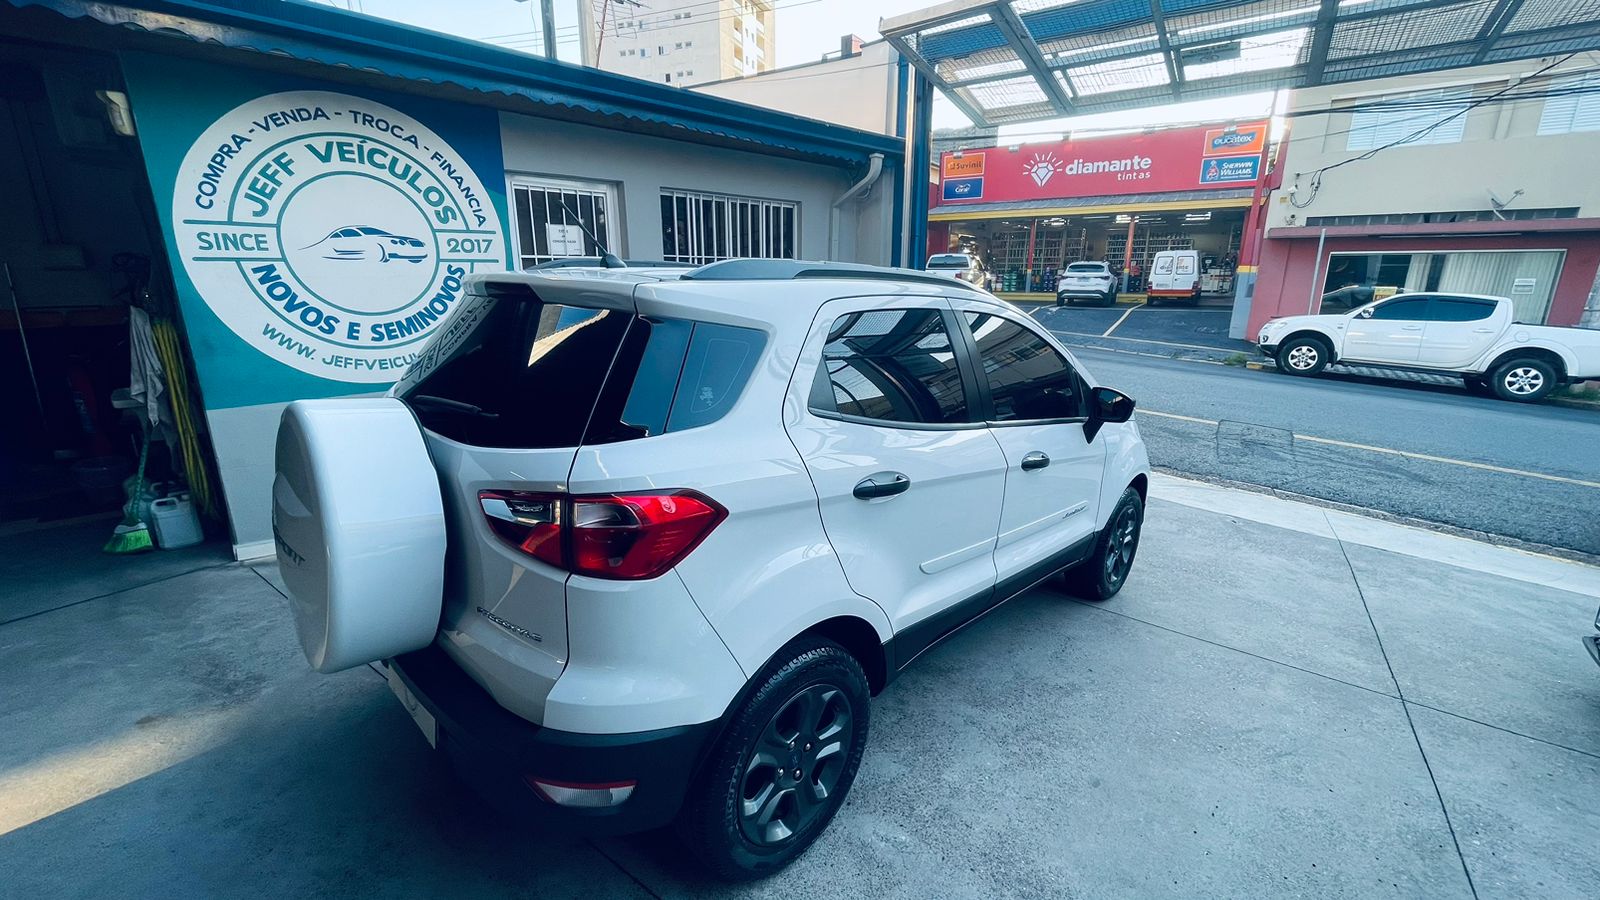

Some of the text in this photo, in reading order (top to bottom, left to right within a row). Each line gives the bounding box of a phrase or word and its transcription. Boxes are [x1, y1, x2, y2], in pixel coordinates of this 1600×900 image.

[1214, 135, 1252, 145] eucatex
[195, 134, 252, 209] COMPRA
[252, 107, 331, 132] VENDA
[349, 110, 419, 149] TROCA
[430, 151, 487, 228] FINANCIA
[956, 160, 982, 170] Suvinil
[1065, 155, 1152, 175] diamante
[244, 140, 457, 225] JEFF VEÍCULOS
[1117, 171, 1151, 181] tintas
[196, 231, 269, 252] SINCE
[446, 237, 493, 254] 2017
[251, 263, 465, 342] NOVOS E SEMINOVOS
[262, 323, 317, 360] WWW.
